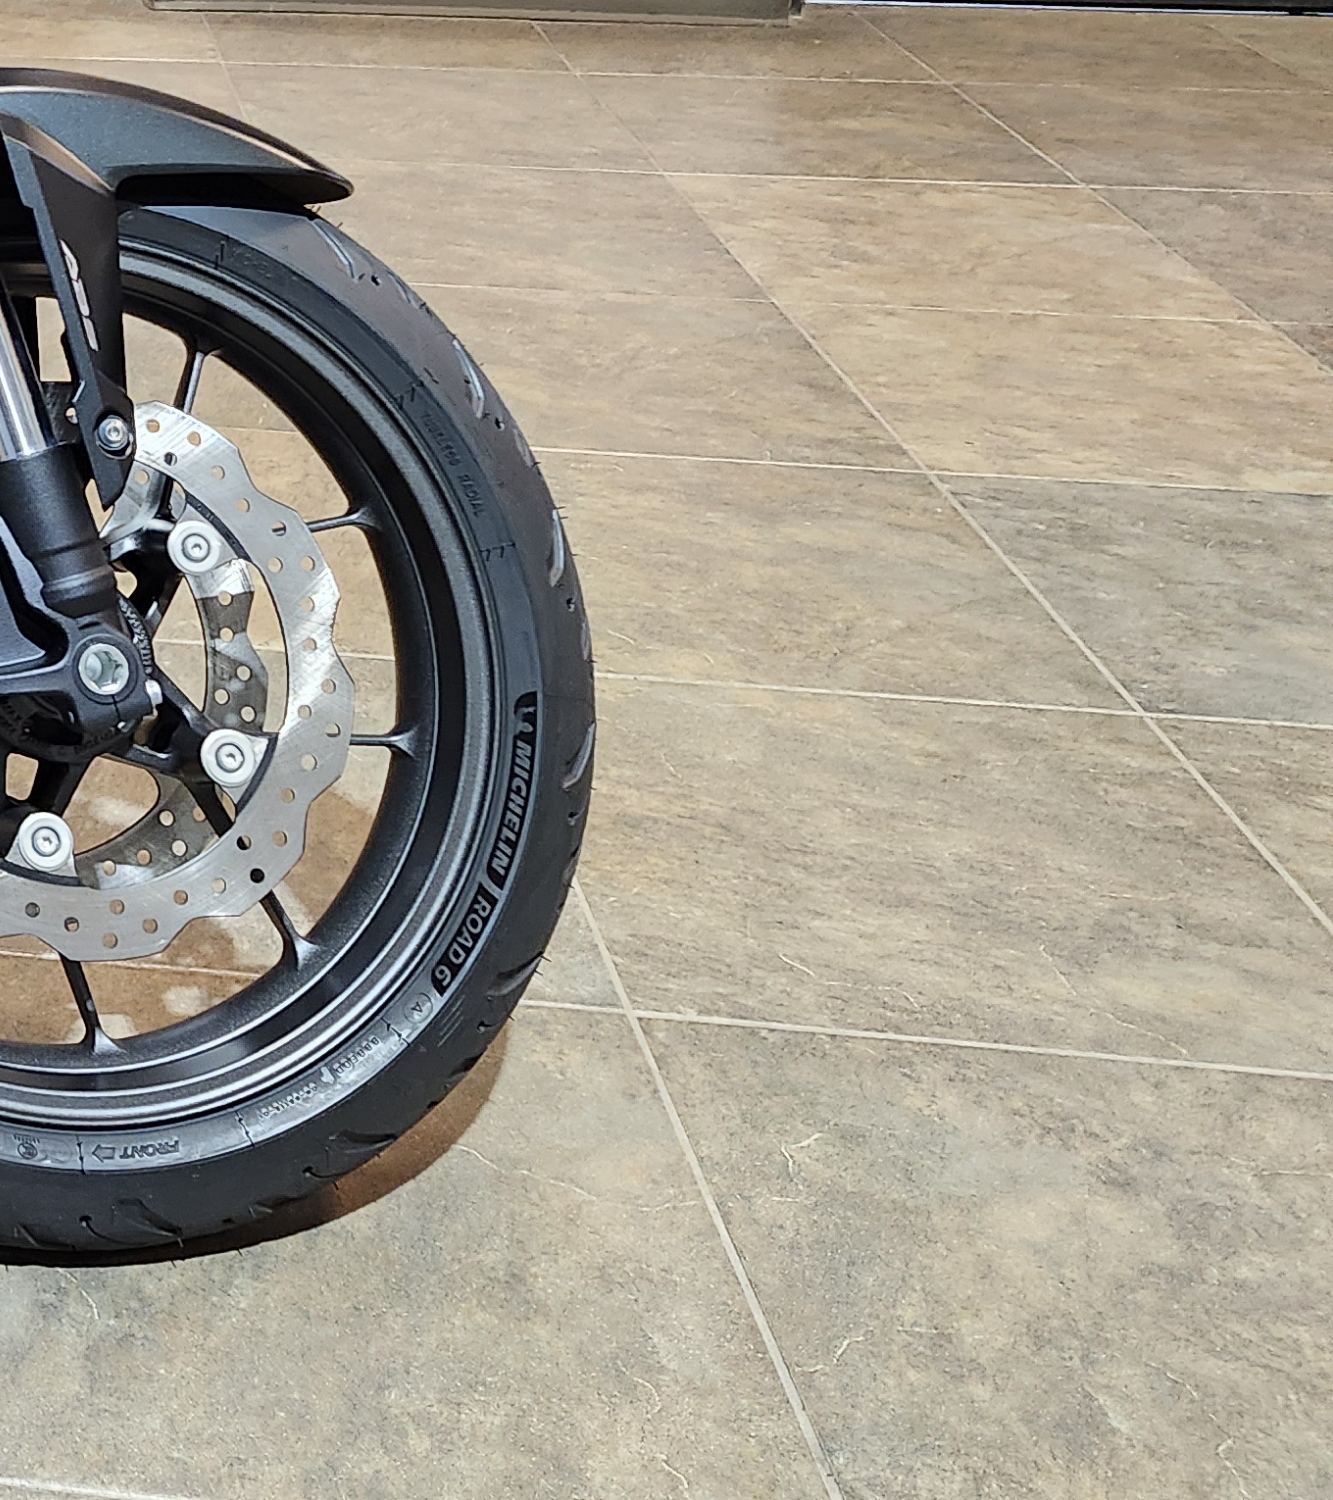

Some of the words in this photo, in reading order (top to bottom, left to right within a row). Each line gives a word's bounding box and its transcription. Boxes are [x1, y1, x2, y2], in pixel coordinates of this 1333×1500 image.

[491, 738, 533, 878] MICHELIN
[450, 894, 492, 965] ROAD
[435, 966, 453, 988] 6
